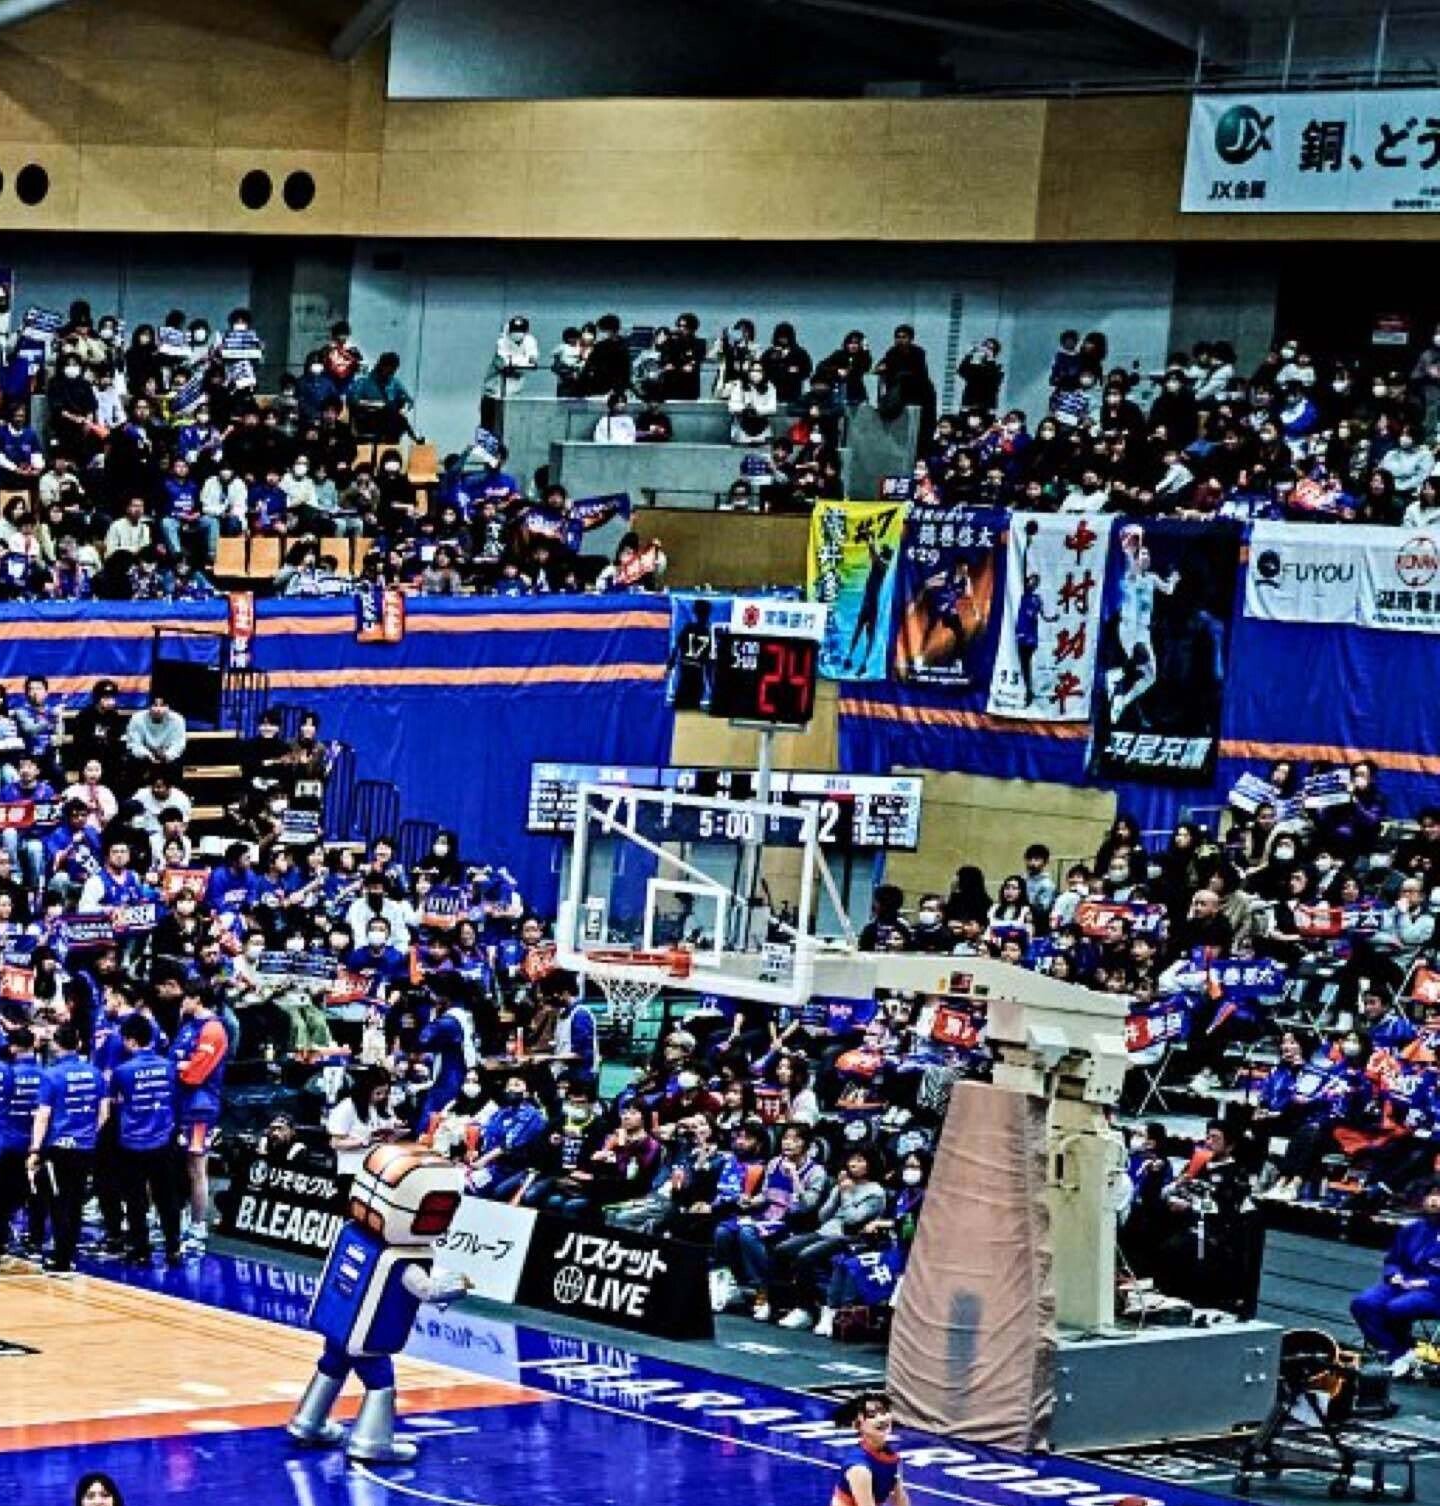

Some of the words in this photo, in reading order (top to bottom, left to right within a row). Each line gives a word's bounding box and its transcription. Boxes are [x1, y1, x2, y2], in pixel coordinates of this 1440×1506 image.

[1283, 562, 1355, 583] FUYOU
[756, 642, 813, 716] 24
[699, 809, 755, 841] 5:00
[268, 1164, 340, 1199] りそなグル
[235, 1194, 345, 1248] B.LEAGU
[553, 1229, 669, 1279] バスケット
[583, 1277, 652, 1317] LIVE
